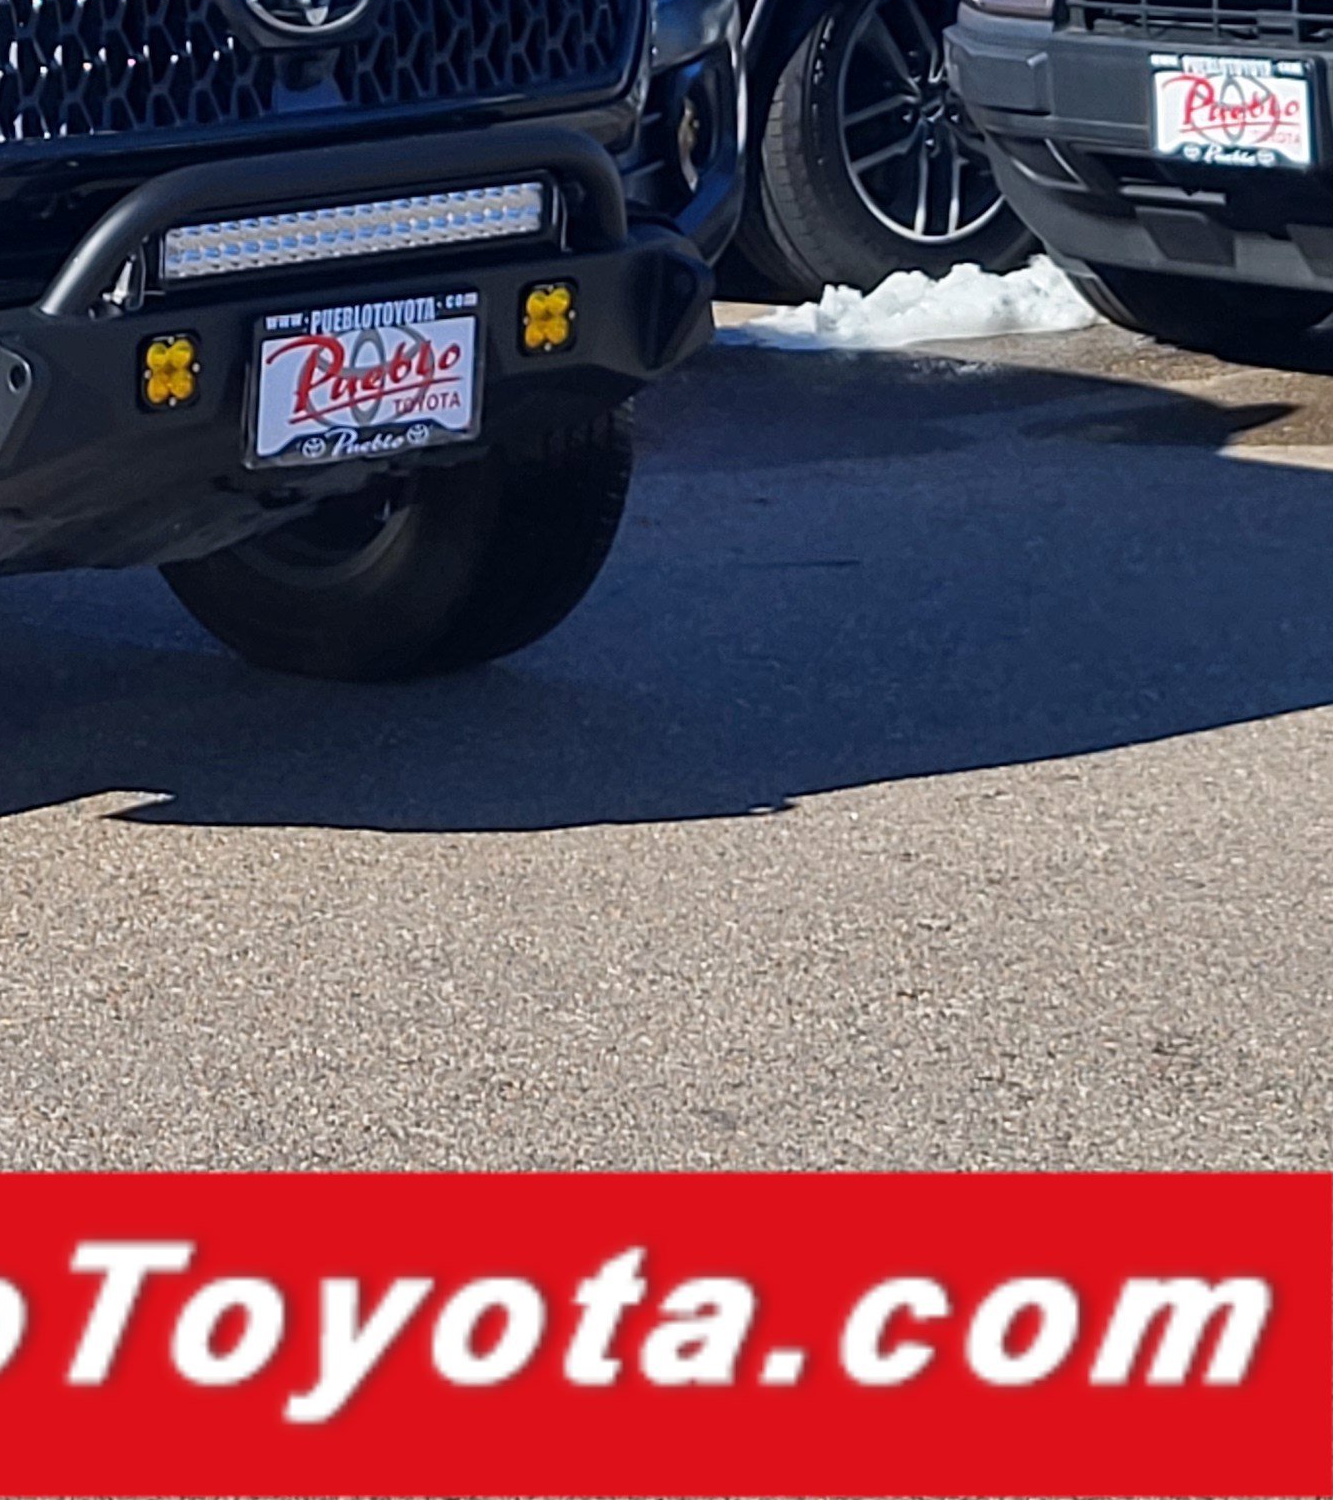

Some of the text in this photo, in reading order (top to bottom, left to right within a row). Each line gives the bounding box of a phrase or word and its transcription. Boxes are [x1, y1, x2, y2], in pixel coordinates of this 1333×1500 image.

[1162, 75, 1300, 125] Pueblo
[266, 334, 462, 414] Pueblo
[393, 391, 462, 414] TOYOTA
[325, 426, 405, 458] Pueblo
